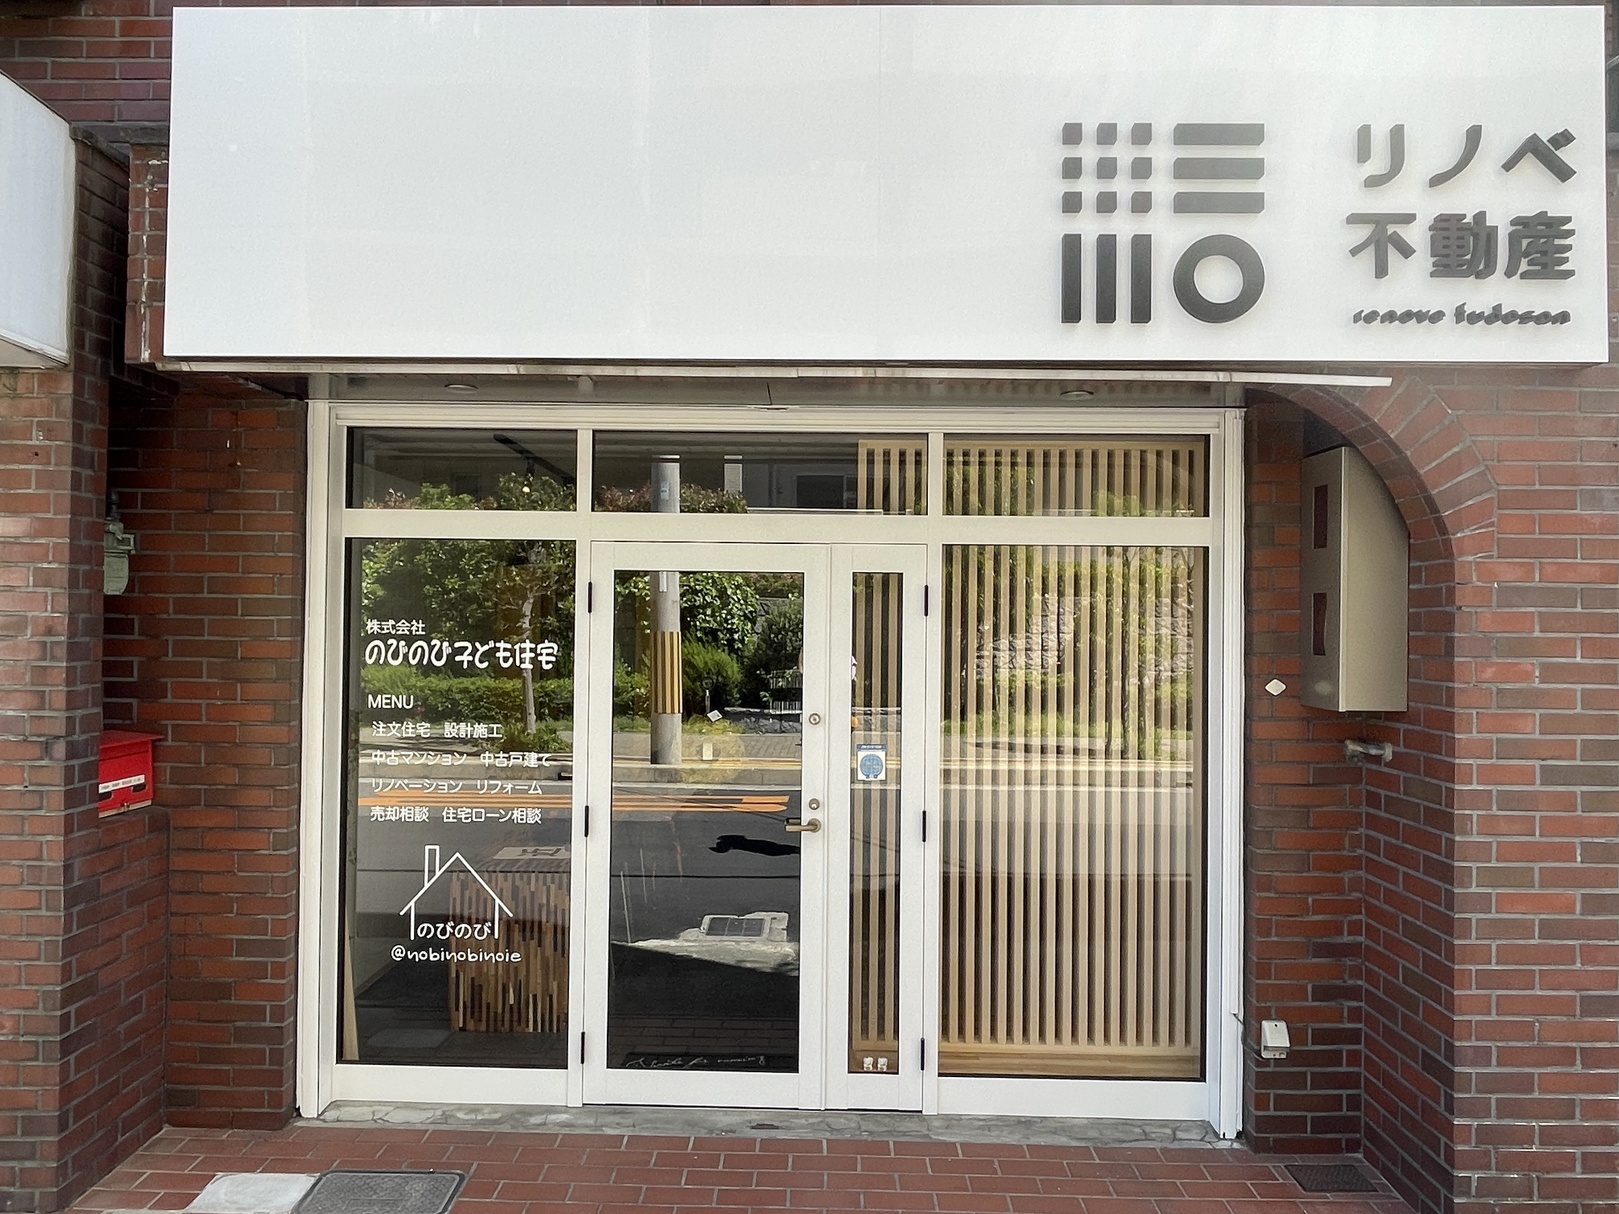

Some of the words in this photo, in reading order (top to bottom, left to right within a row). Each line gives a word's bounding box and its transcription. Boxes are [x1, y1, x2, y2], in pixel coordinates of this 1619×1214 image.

[1356, 123, 1577, 188] リノベ
[1345, 210, 1576, 280] 不動産
[1352, 309, 1446, 325] renove
[366, 619, 426, 635] 株式会社
[365, 639, 558, 669] のびのび子ども住宅
[367, 694, 414, 709] MENU
[371, 721, 431, 738] 注文住宅
[444, 723, 503, 738] 設計施工
[371, 750, 467, 767] 中古マンション
[480, 753, 552, 768] 中古戸建て
[371, 778, 463, 794] リノベーション
[476, 780, 543, 795] リフォーム
[370, 806, 430, 823] 売却相談
[442, 807, 542, 824] 住宅ローン相談
[416, 921, 493, 940] のびのび
[390, 944, 522, 963] @nobinobinoie
